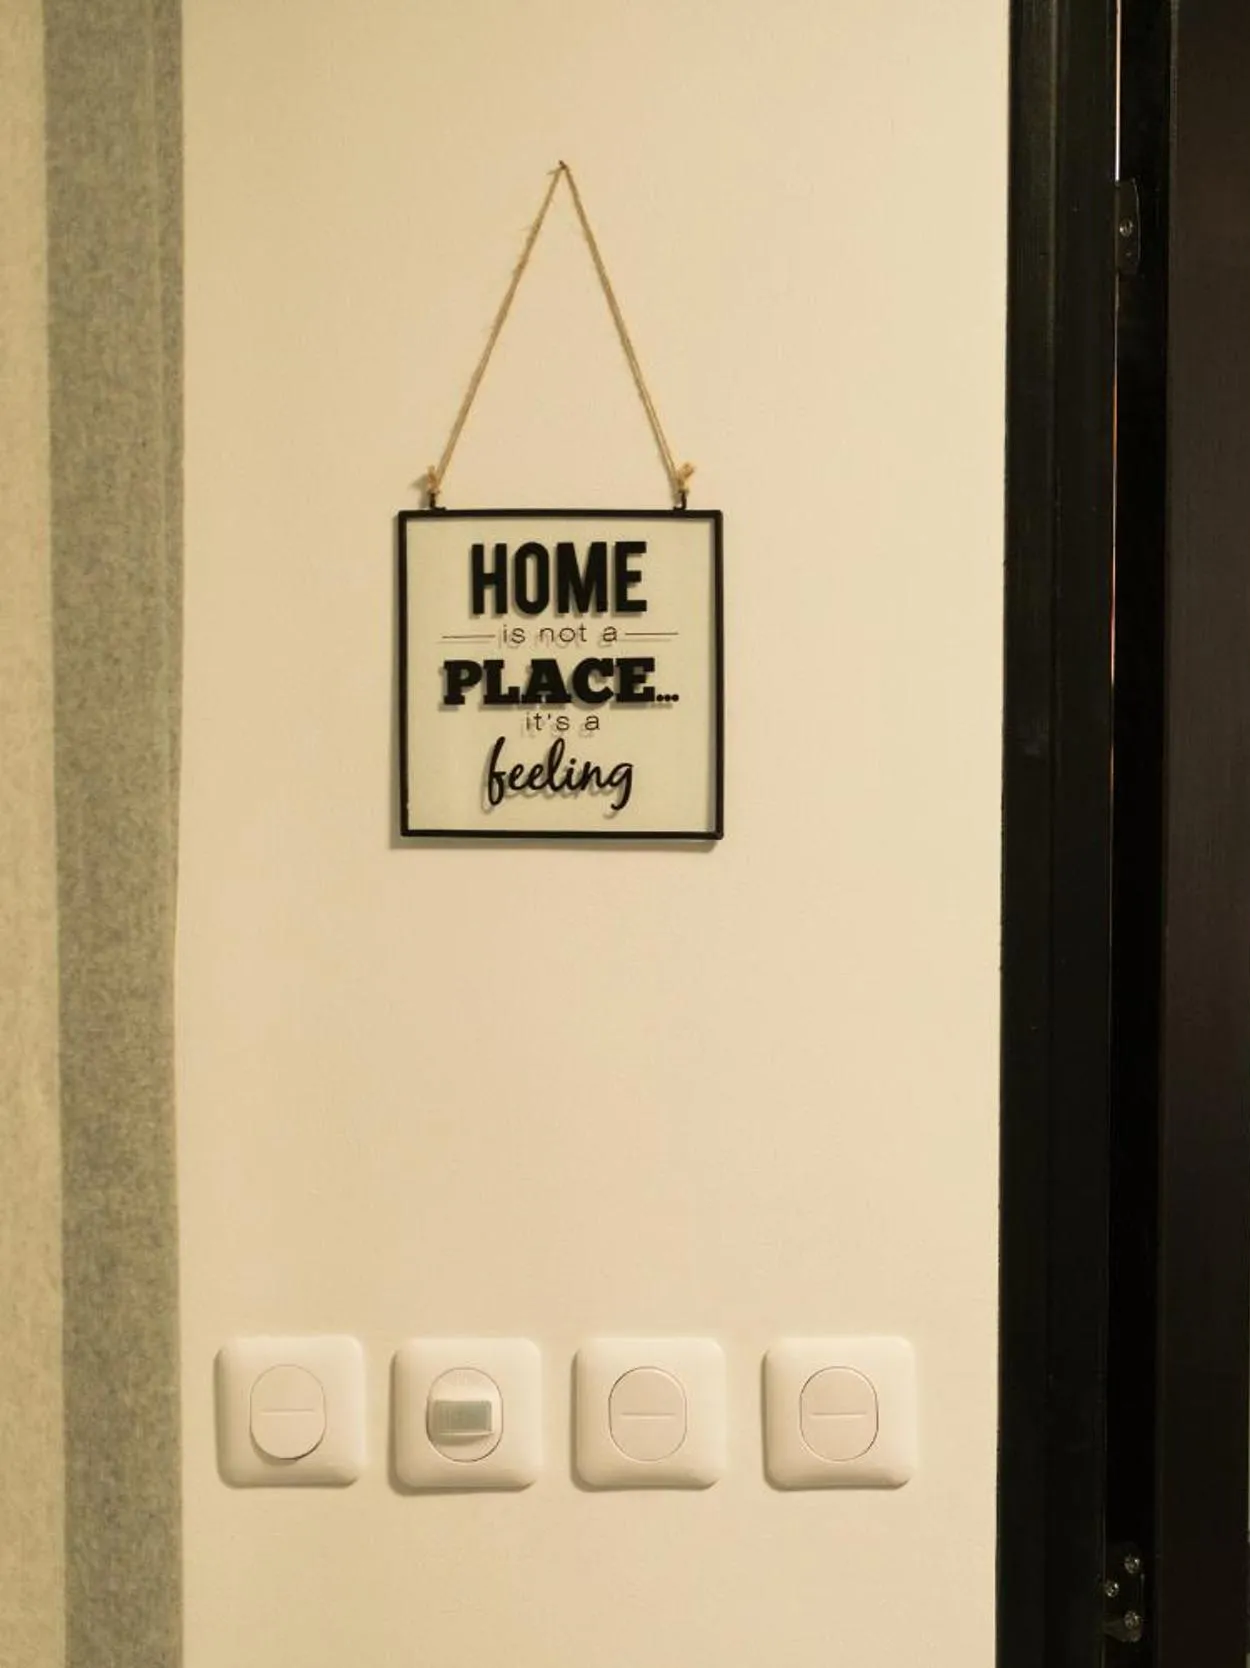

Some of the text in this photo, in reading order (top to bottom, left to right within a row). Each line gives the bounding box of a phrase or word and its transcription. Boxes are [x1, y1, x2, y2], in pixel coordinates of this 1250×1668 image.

[471, 541, 647, 614] HOME
[502, 624, 619, 644] is not a
[443, 657, 680, 705] PLACE...
[525, 712, 601, 731] it's a
[487, 736, 635, 811] feeling
